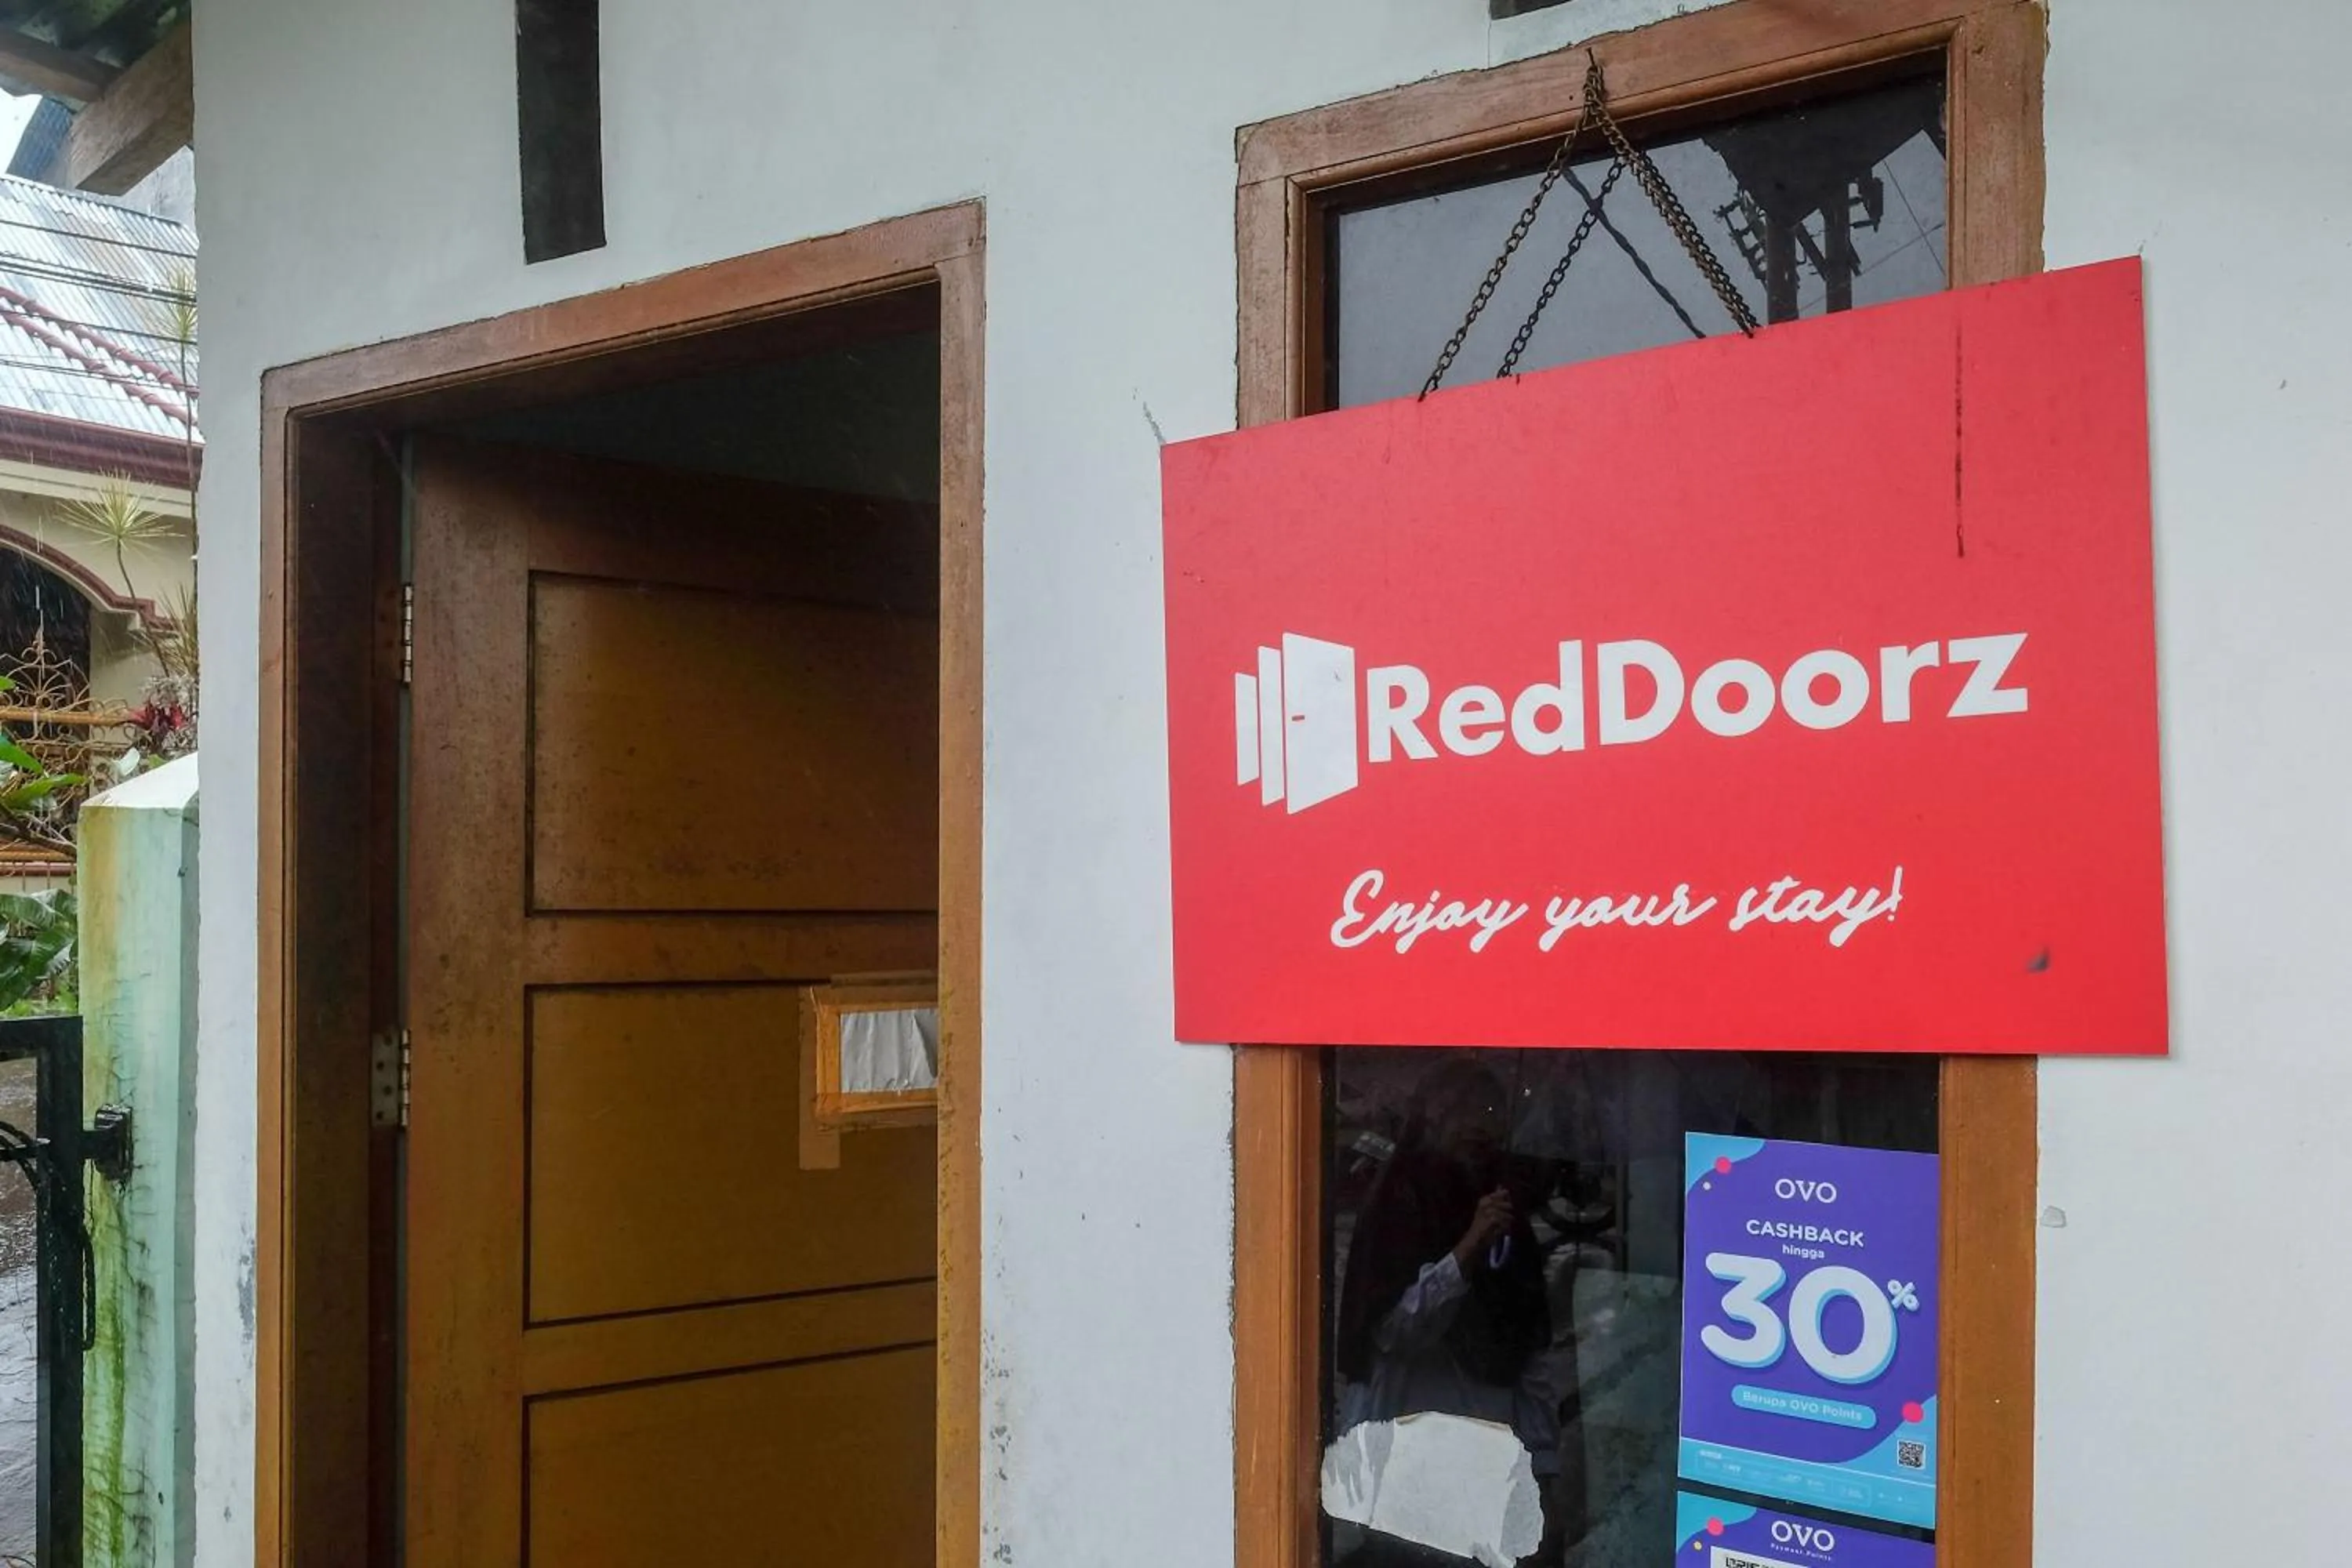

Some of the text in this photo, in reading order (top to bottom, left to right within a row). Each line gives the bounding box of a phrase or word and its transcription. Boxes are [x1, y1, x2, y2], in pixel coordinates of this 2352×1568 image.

[1367, 632, 2029, 763] RedDoorz
[1330, 865, 1904, 955] Enjoy your stay!
[1774, 1178, 1837, 1203] OVO
[1746, 1219, 1864, 1247] CASHBACK
[1782, 1244, 1825, 1260] hingga
[1743, 1391, 1863, 1421] Berupa OVO Points
[1771, 1520, 1835, 1552] OVO
